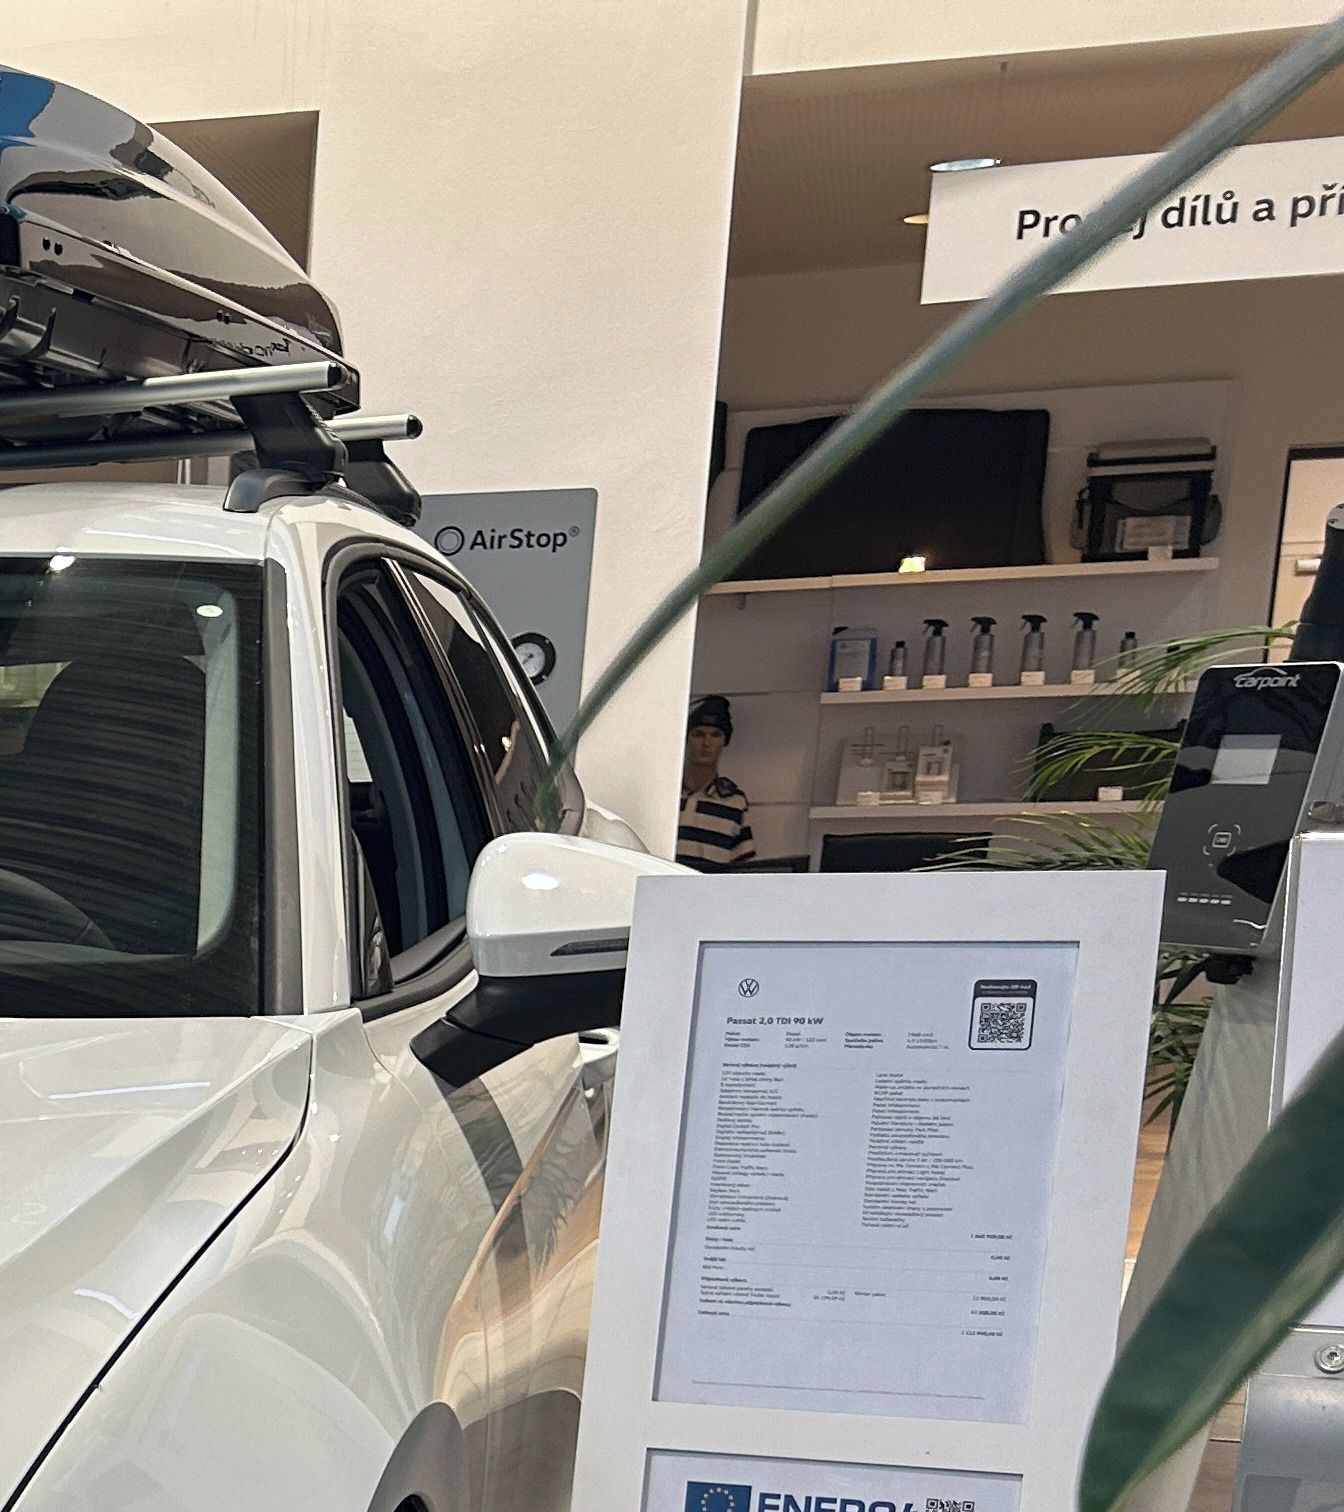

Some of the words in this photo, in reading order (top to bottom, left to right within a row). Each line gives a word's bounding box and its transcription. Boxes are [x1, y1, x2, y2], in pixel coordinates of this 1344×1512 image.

[1161, 190, 1239, 229] dílů
[1252, 198, 1276, 222] a
[726, 1016, 756, 1025] Passat
[776, 1017, 791, 1025] TDI
[793, 1017, 805, 1025] 90
[807, 1017, 824, 1025] kW
